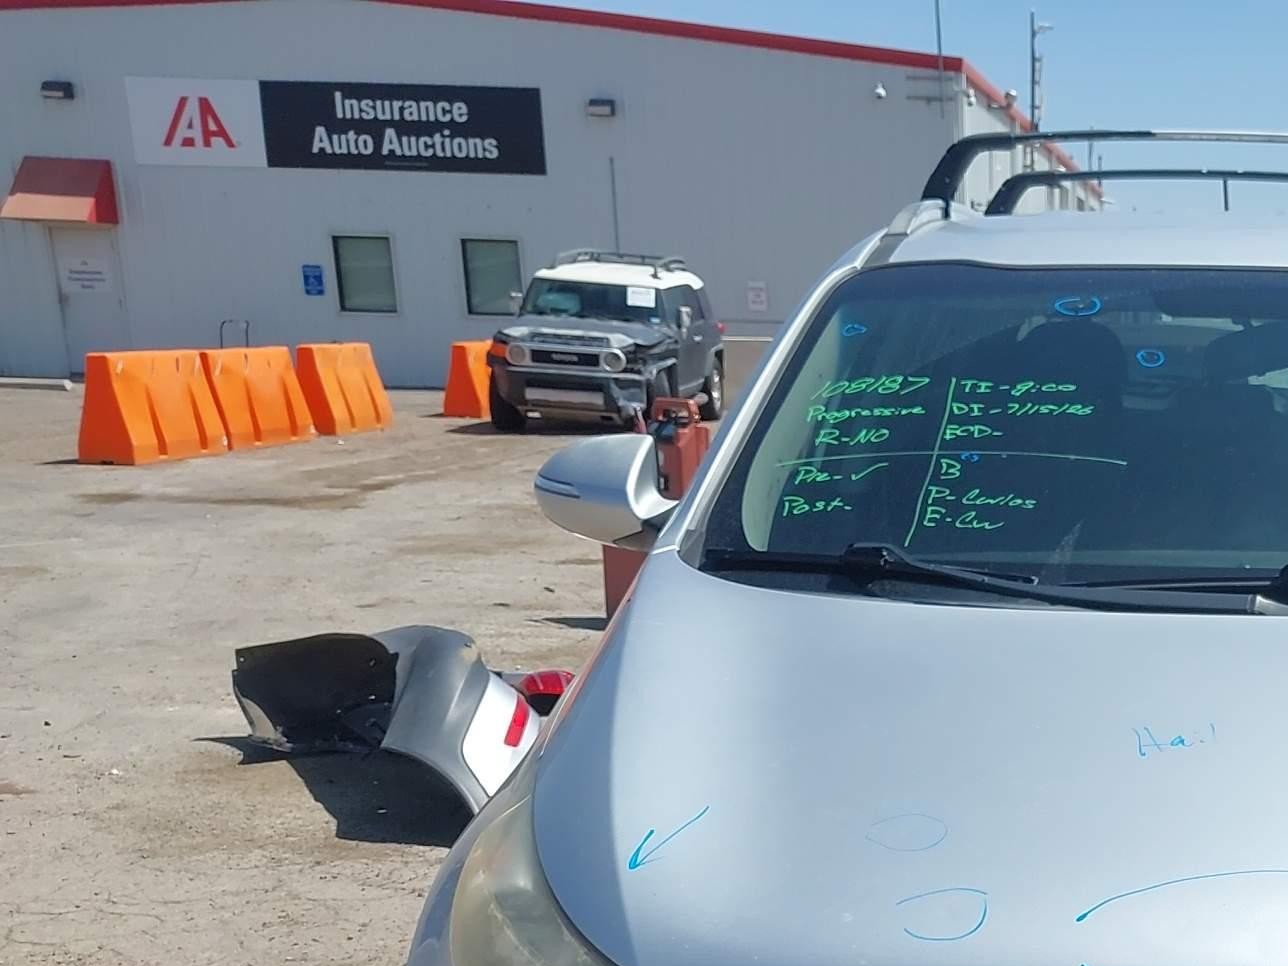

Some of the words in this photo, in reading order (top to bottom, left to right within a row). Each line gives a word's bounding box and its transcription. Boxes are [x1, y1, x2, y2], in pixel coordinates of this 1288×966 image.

[334, 91, 469, 123] Insurance
[311, 126, 375, 155] Auto
[381, 128, 500, 160] Auctions
